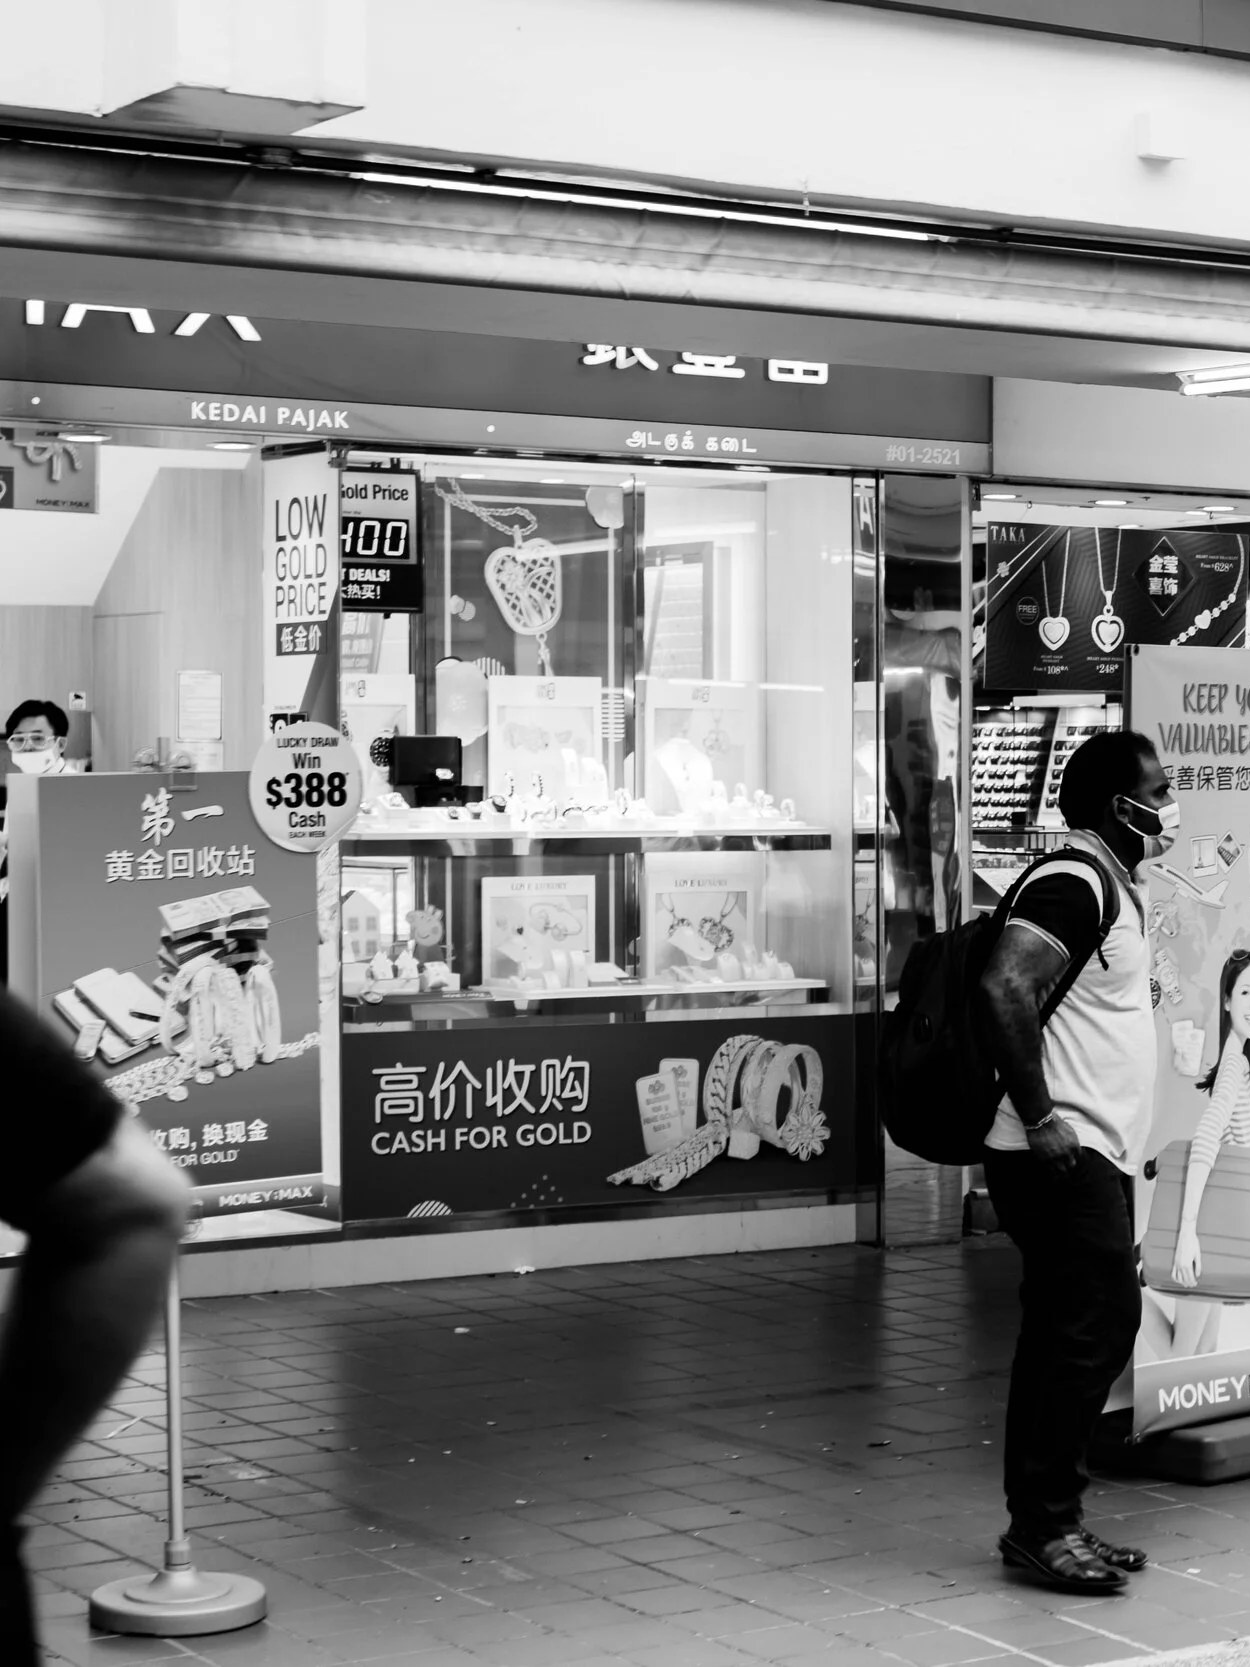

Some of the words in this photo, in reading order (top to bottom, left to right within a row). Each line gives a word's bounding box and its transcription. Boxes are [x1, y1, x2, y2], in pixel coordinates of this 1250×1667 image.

[191, 402, 266, 424] KEDAI
[277, 408, 349, 431] PAJAK
[886, 444, 960, 466] #01-2521
[372, 484, 409, 500] Price
[275, 494, 327, 543] LOW
[990, 526, 1025, 542] TAKA
[275, 543, 327, 582] GOLD
[349, 568, 390, 582] DEALS!
[275, 582, 327, 618] PRICE
[1018, 605, 1037, 613] FREE
[281, 624, 322, 653] 低金价
[1182, 683, 1229, 714] KEEP
[276, 737, 308, 748] LUCKY
[311, 736, 340, 747] DRAW
[292, 752, 321, 769] Win
[140, 786, 225, 846] 第一
[288, 811, 326, 828] Cash
[104, 844, 256, 883] 黄金回收站
[371, 1054, 591, 1124] 高价收购
[371, 1130, 447, 1156] CASH
[454, 1126, 508, 1150] FOR
[516, 1121, 592, 1146] GOLD
